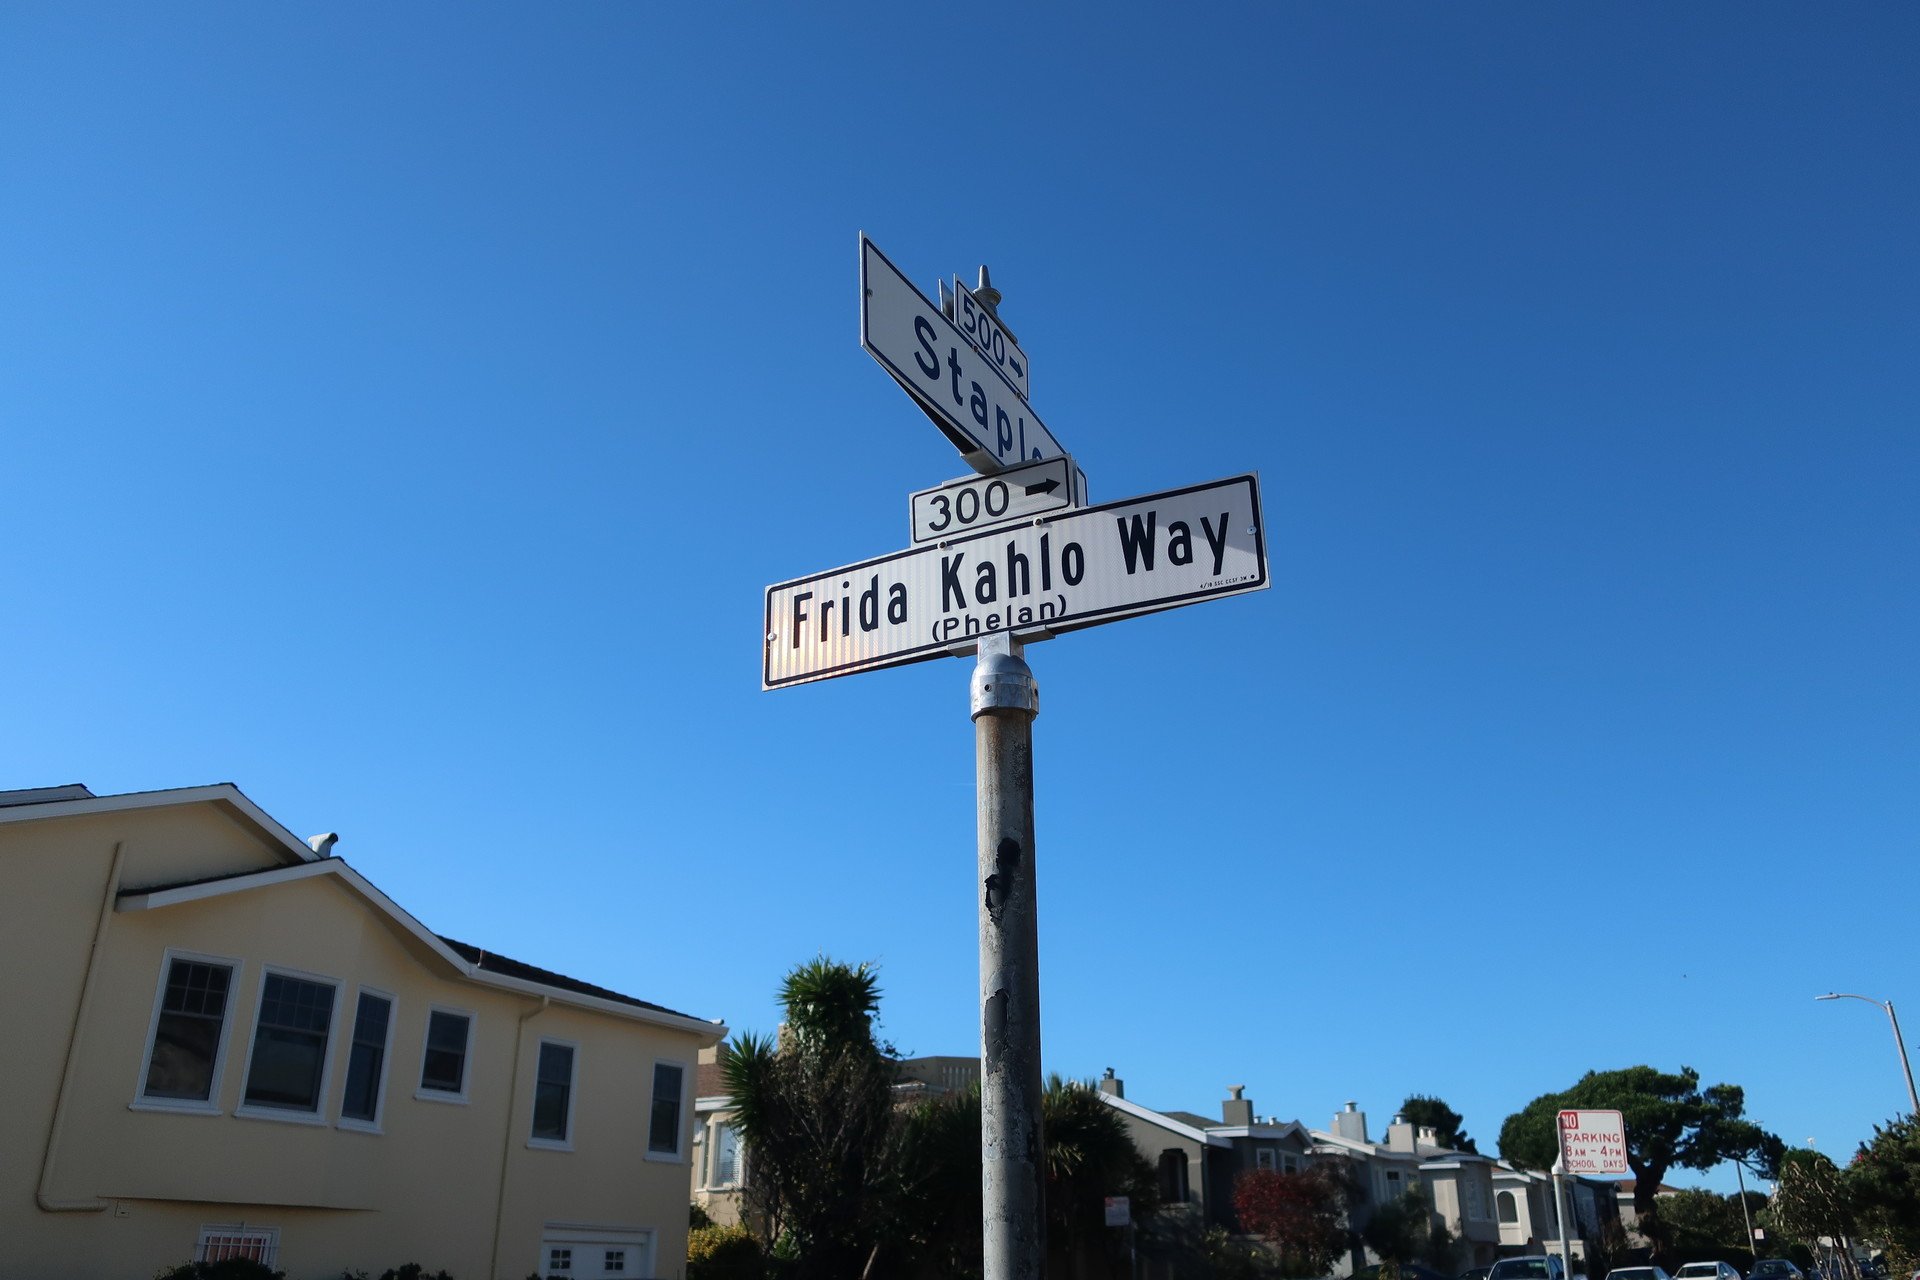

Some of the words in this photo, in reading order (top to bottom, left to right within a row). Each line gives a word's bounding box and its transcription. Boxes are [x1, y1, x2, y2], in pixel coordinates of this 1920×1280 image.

[963, 294, 1004, 366] 500
[929, 480, 1009, 531] 300
[793, 574, 907, 648] Frida
[941, 533, 1085, 613] Kahlo
[1117, 511, 1230, 575] Way
[931, 594, 1067, 642] (Phelan)
[1561, 1114, 1577, 1128] NO
[1564, 1133, 1620, 1143] PARKING
[1567, 1160, 1596, 1168] SCHOOL
[1603, 1160, 1624, 1168] DAYS
